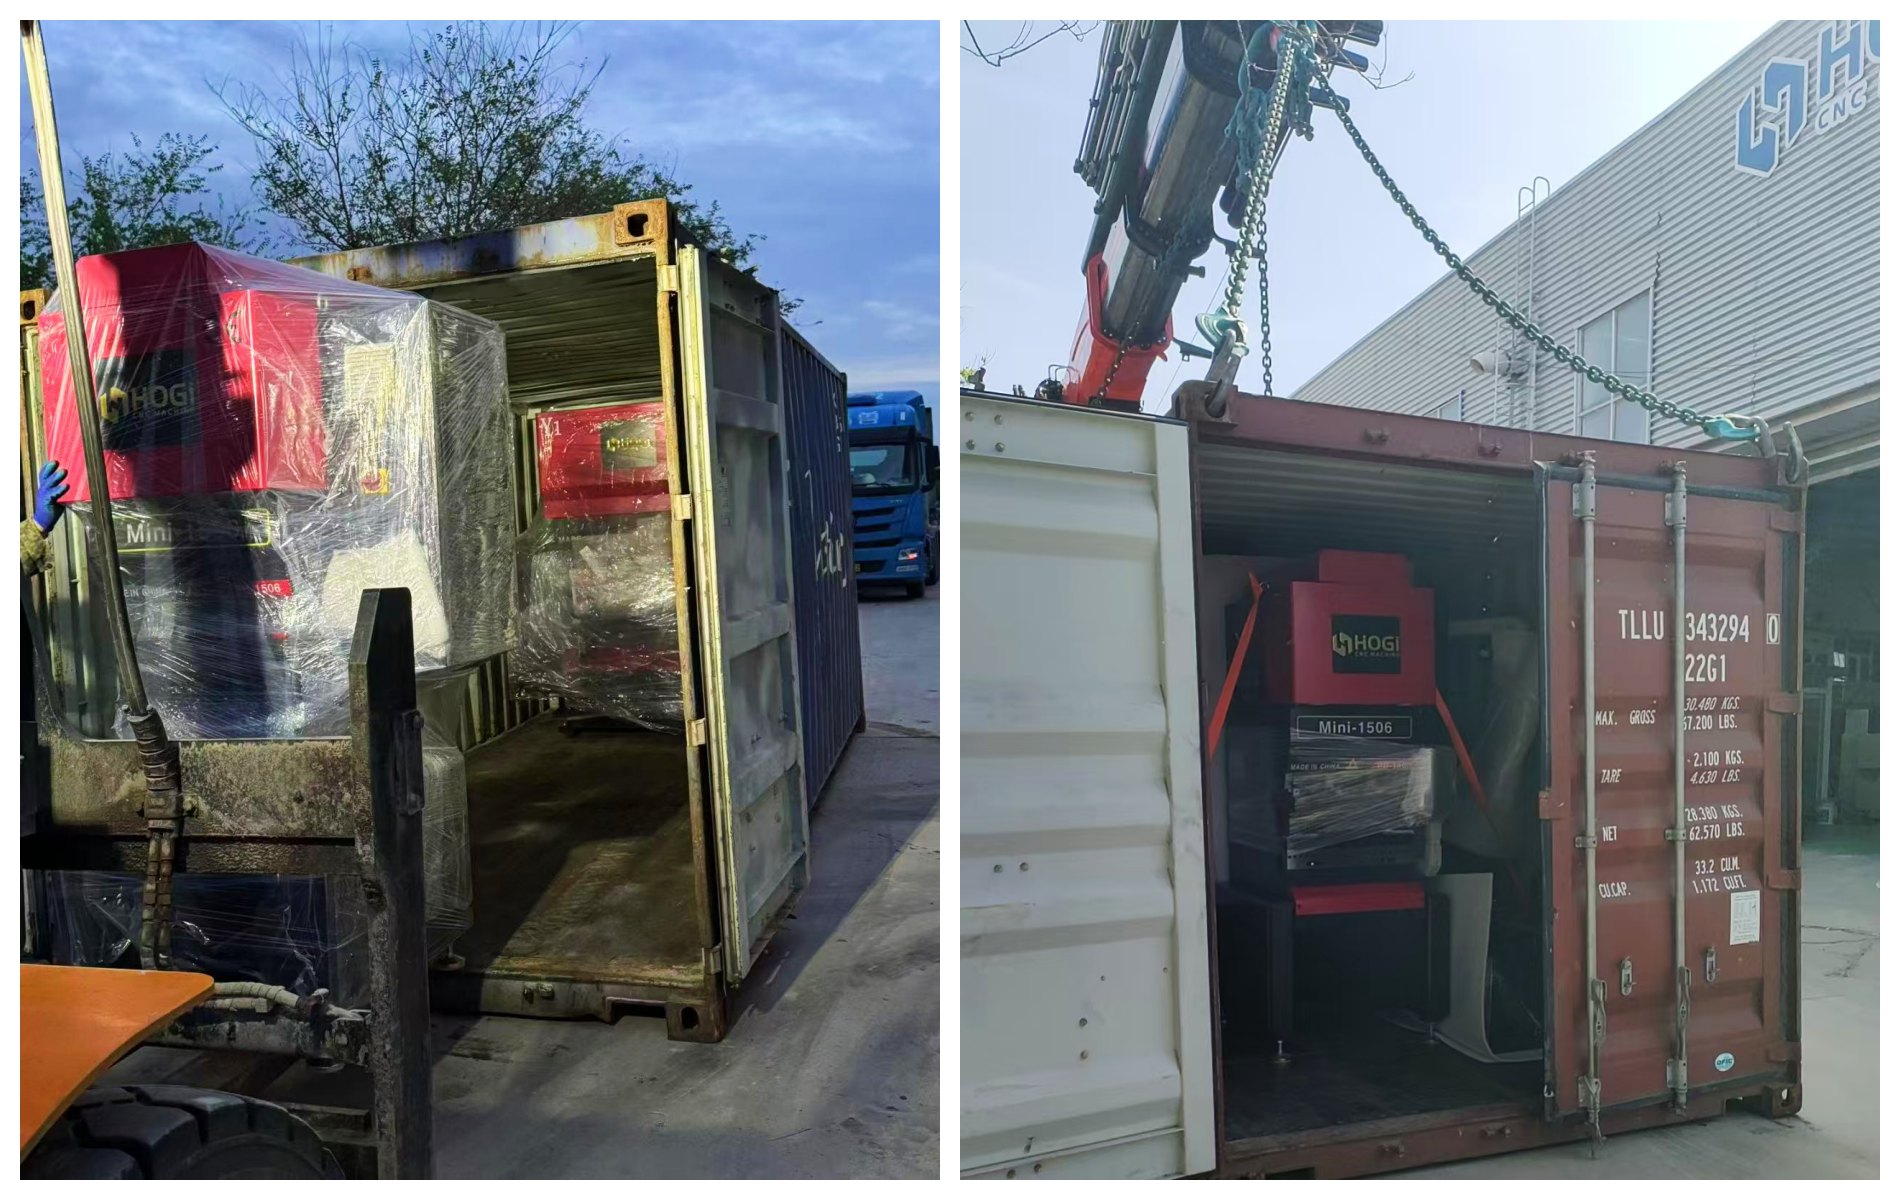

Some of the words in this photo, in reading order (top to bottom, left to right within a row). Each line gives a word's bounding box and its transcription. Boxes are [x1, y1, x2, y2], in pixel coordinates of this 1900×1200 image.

[1818, 87, 1863, 130] CNC
[1618, 609, 1665, 640] TLLU
[1685, 612, 1750, 643] 343294
[1767, 614, 1779, 643] 0
[1685, 653, 1727, 682] 22G1
[1684, 697, 1718, 712] 30.480
[1721, 696, 1741, 710] KGS.
[1595, 710, 1618, 726] MAX.
[1629, 709, 1656, 725] GROSS
[1718, 714, 1738, 729] LBS.
[1319, 721, 1393, 734] Mini-1506
[1693, 752, 1720, 767] 2.100
[1725, 749, 1745, 765] KGS.
[1600, 768, 1623, 784] TARE
[1690, 770, 1718, 785] 4.630
[1721, 768, 1741, 783] LBS.
[1685, 806, 1718, 822] 28.380
[1721, 804, 1743, 819] KGS.
[1602, 825, 1617, 842] NET
[1689, 824, 1721, 841] 62.570
[1726, 821, 1745, 837] LBS.
[1695, 860, 1715, 875] 33.2
[1598, 882, 1632, 898] CU.CAP.
[1692, 878, 1720, 895] 1.172
